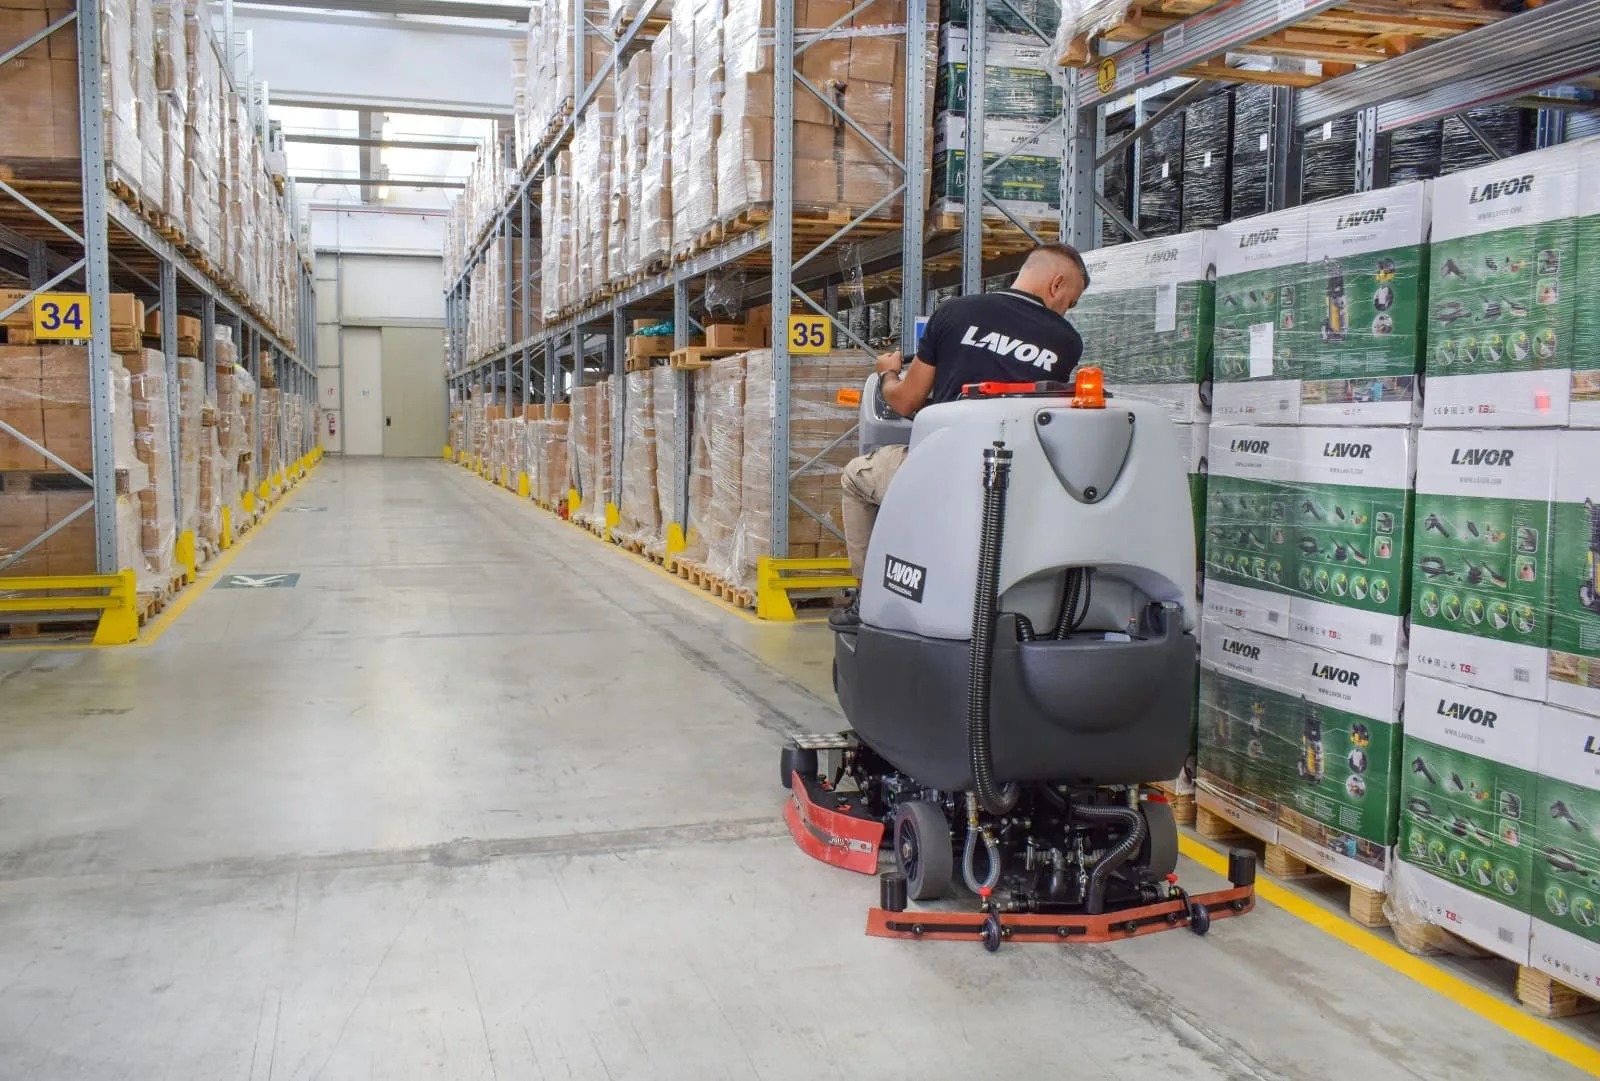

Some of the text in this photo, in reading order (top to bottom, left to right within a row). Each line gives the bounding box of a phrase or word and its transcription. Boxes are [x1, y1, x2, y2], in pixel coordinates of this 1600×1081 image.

[1469, 174, 1535, 204] LAVOR
[1336, 207, 1387, 230] LAVOR
[1239, 228, 1279, 248] LAVOR
[41, 302, 83, 330] 34
[793, 323, 825, 347] 35
[960, 325, 1058, 372] LAVOR
[1230, 440, 1269, 454] LAVOR
[1323, 443, 1372, 458] LAVOR
[1451, 449, 1514, 466] LAVOR
[886, 559, 922, 590] LAVOR
[1222, 638, 1261, 661] LAVOR
[1311, 662, 1360, 687] LAVOR
[1436, 699, 1498, 728] LAVOR
